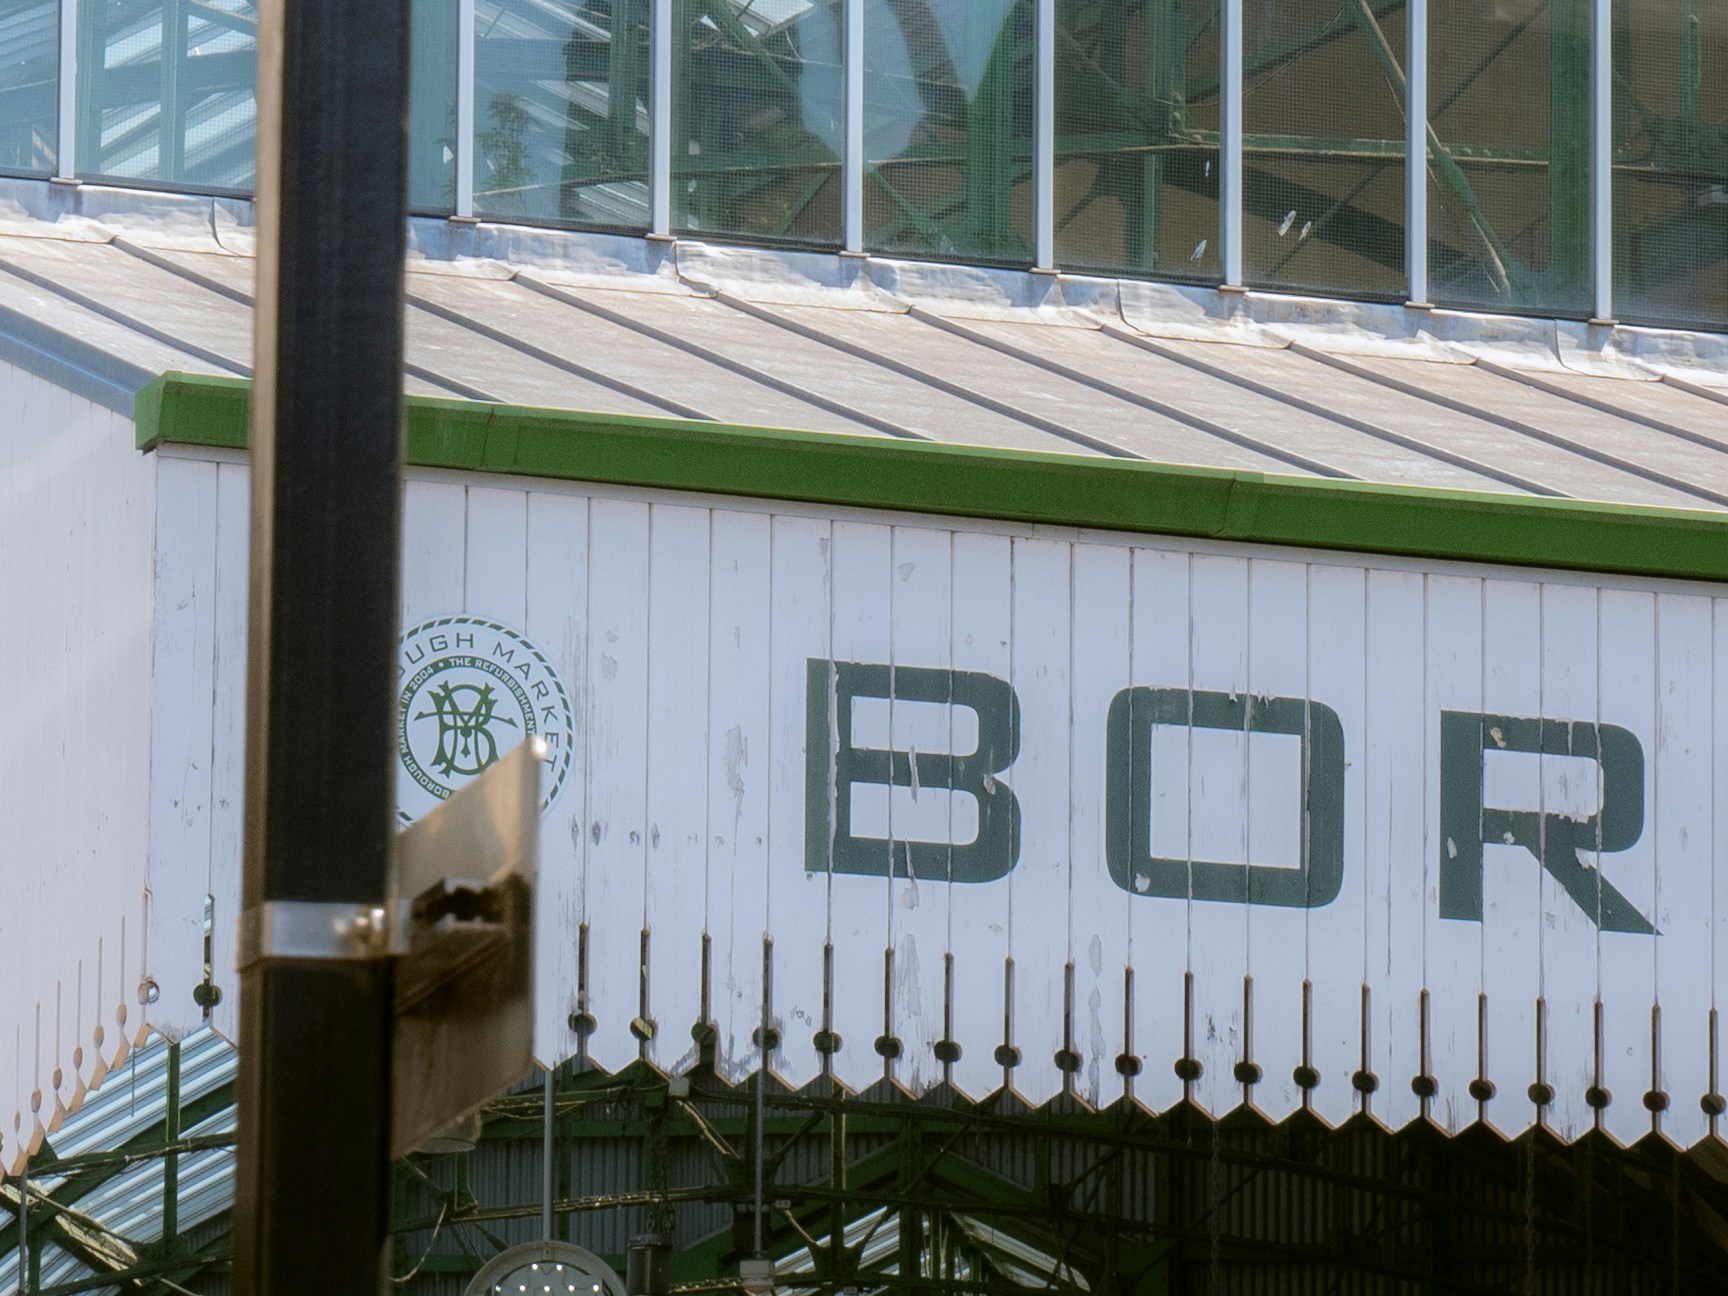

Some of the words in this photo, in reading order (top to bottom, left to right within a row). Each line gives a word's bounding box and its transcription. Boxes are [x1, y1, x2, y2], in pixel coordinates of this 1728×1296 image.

[410, 666, 435, 691] 2004
[448, 656, 472, 668] THE
[474, 659, 537, 735] REFURBISHMENT
[492, 641, 559, 772] MARKET
[404, 755, 452, 799] BOROUGH
